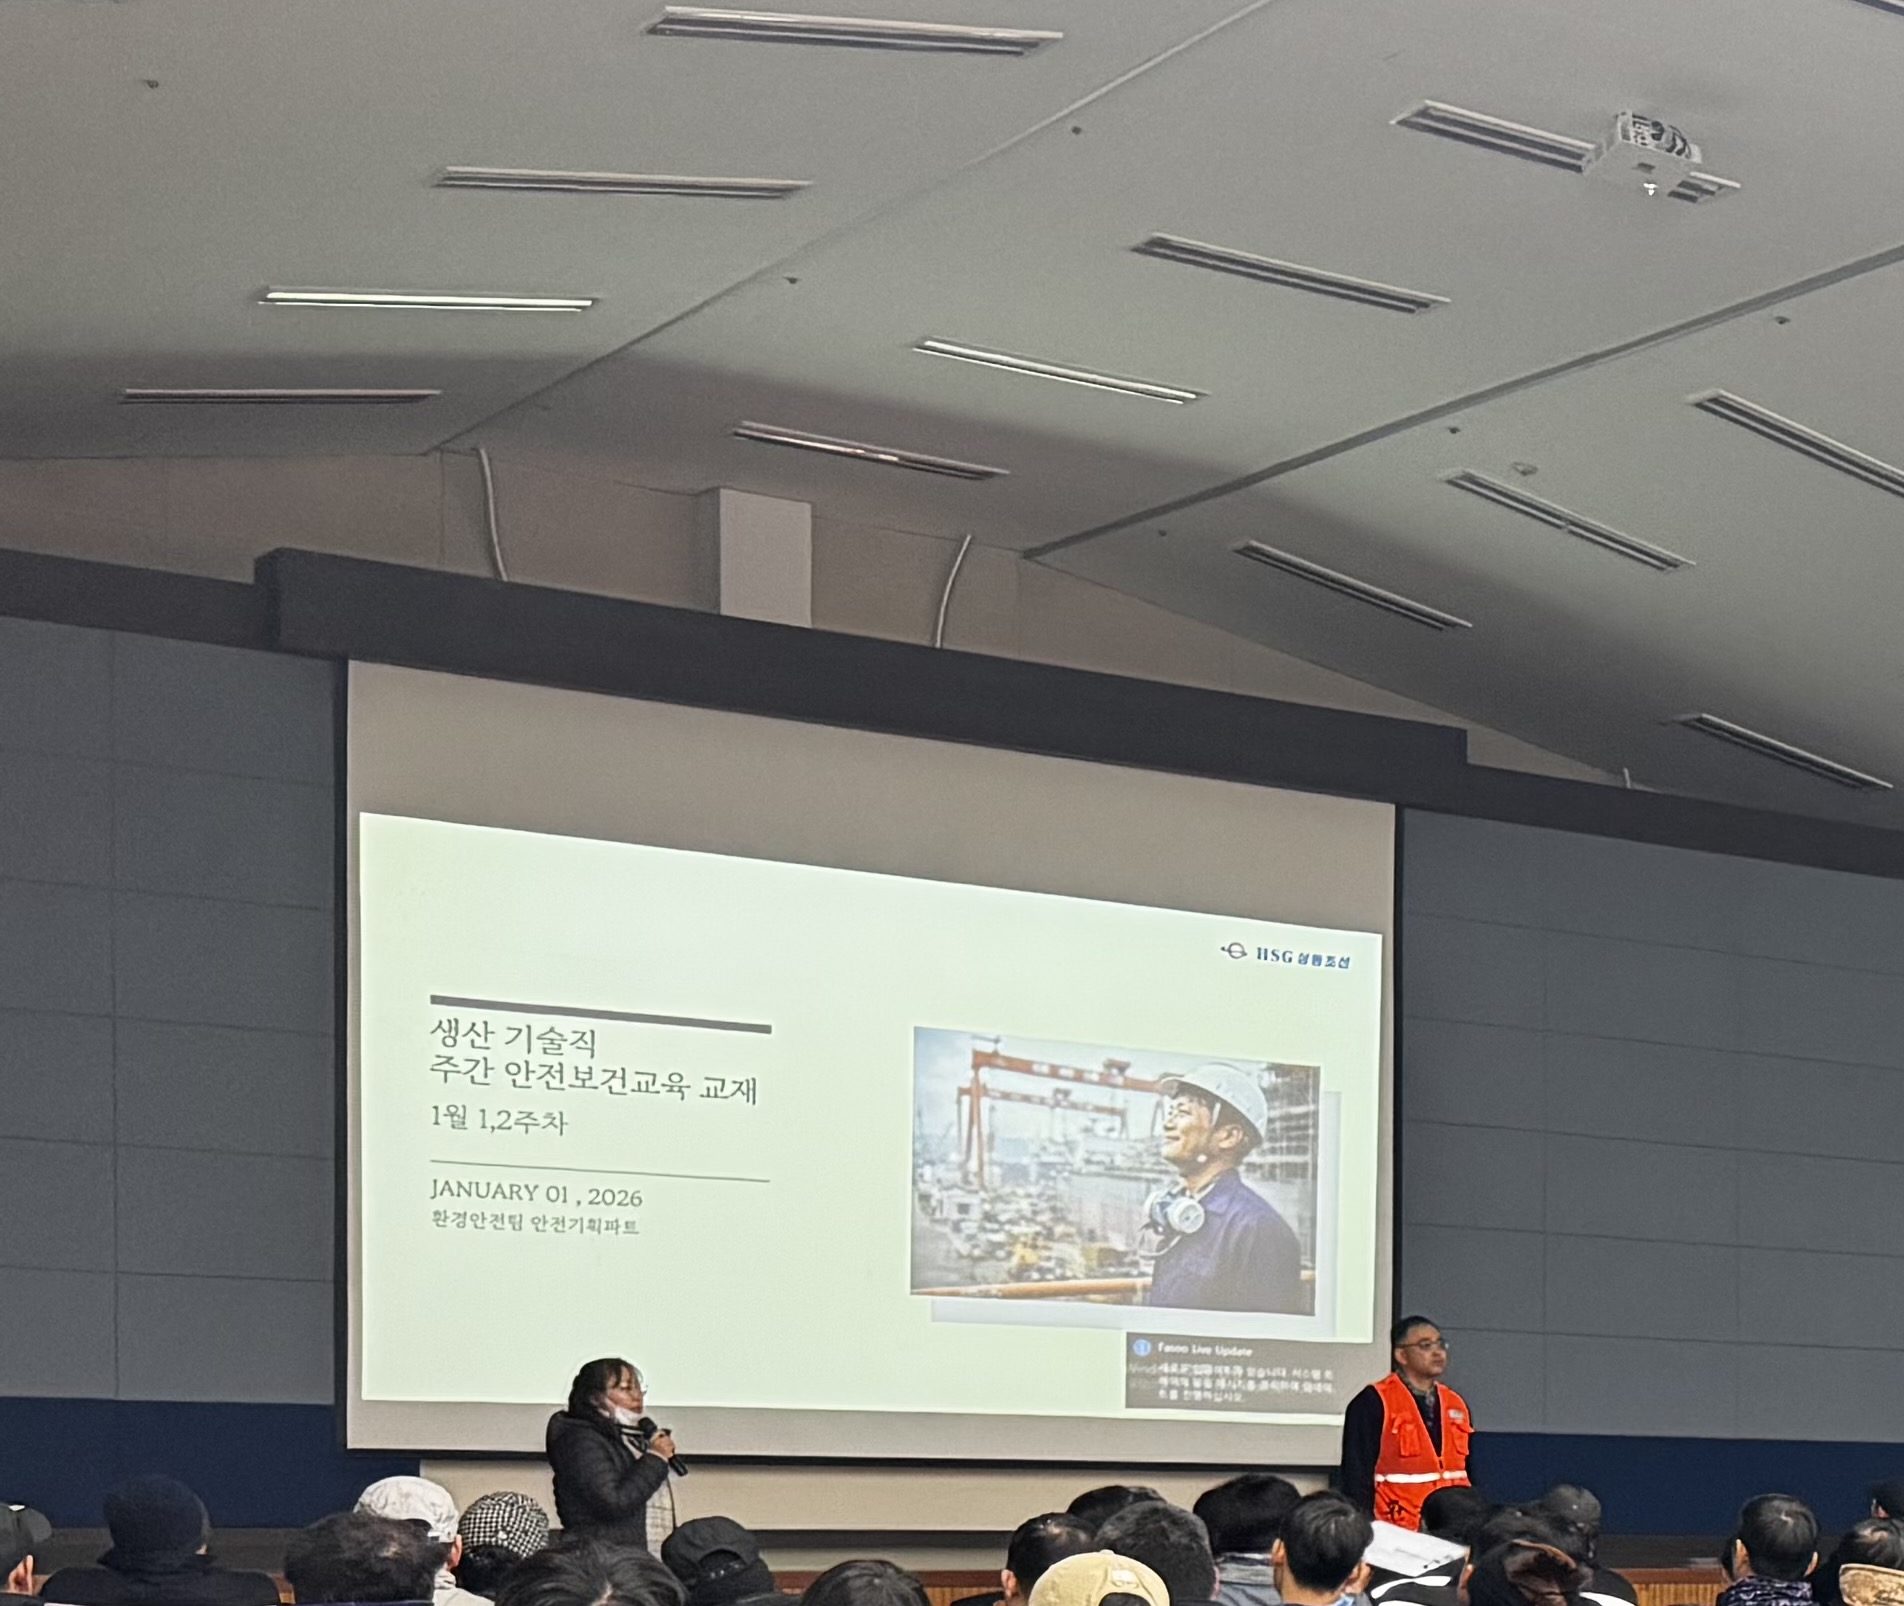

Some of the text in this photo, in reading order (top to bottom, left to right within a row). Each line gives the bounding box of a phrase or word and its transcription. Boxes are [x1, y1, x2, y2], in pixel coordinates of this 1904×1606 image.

[1257, 946, 1294, 964] HSG
[429, 1017, 597, 1059] 생산 기술직
[429, 1054, 758, 1106] 주간 안전보건교육 교재
[431, 1104, 569, 1137] 1월 1,2주차
[429, 1178, 540, 1202] JANUARY
[545, 1185, 568, 1204] 01
[587, 1188, 643, 1208] 2026
[432, 1209, 640, 1236] 환경안전팀 안전기획파트
